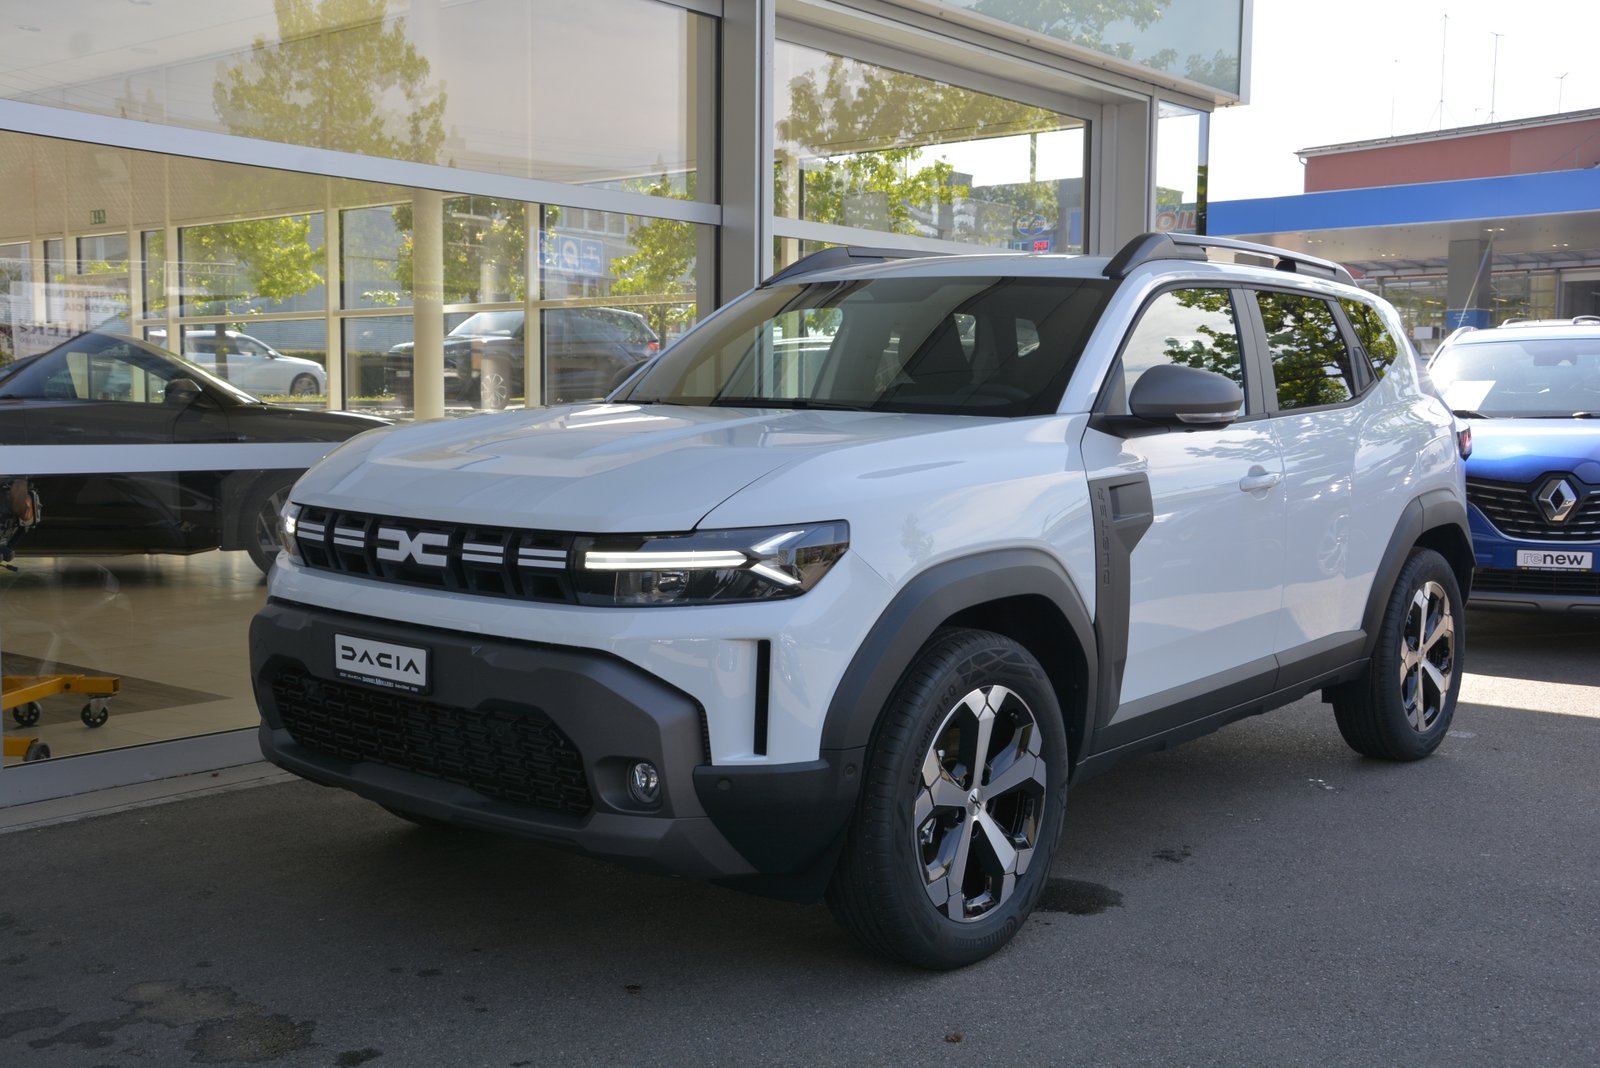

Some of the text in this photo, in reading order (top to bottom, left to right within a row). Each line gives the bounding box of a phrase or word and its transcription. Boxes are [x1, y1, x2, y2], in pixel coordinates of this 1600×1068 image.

[1097, 487, 1110, 585] DUSTER
[1524, 552, 1584, 565] renew
[341, 644, 420, 675] DACIA
